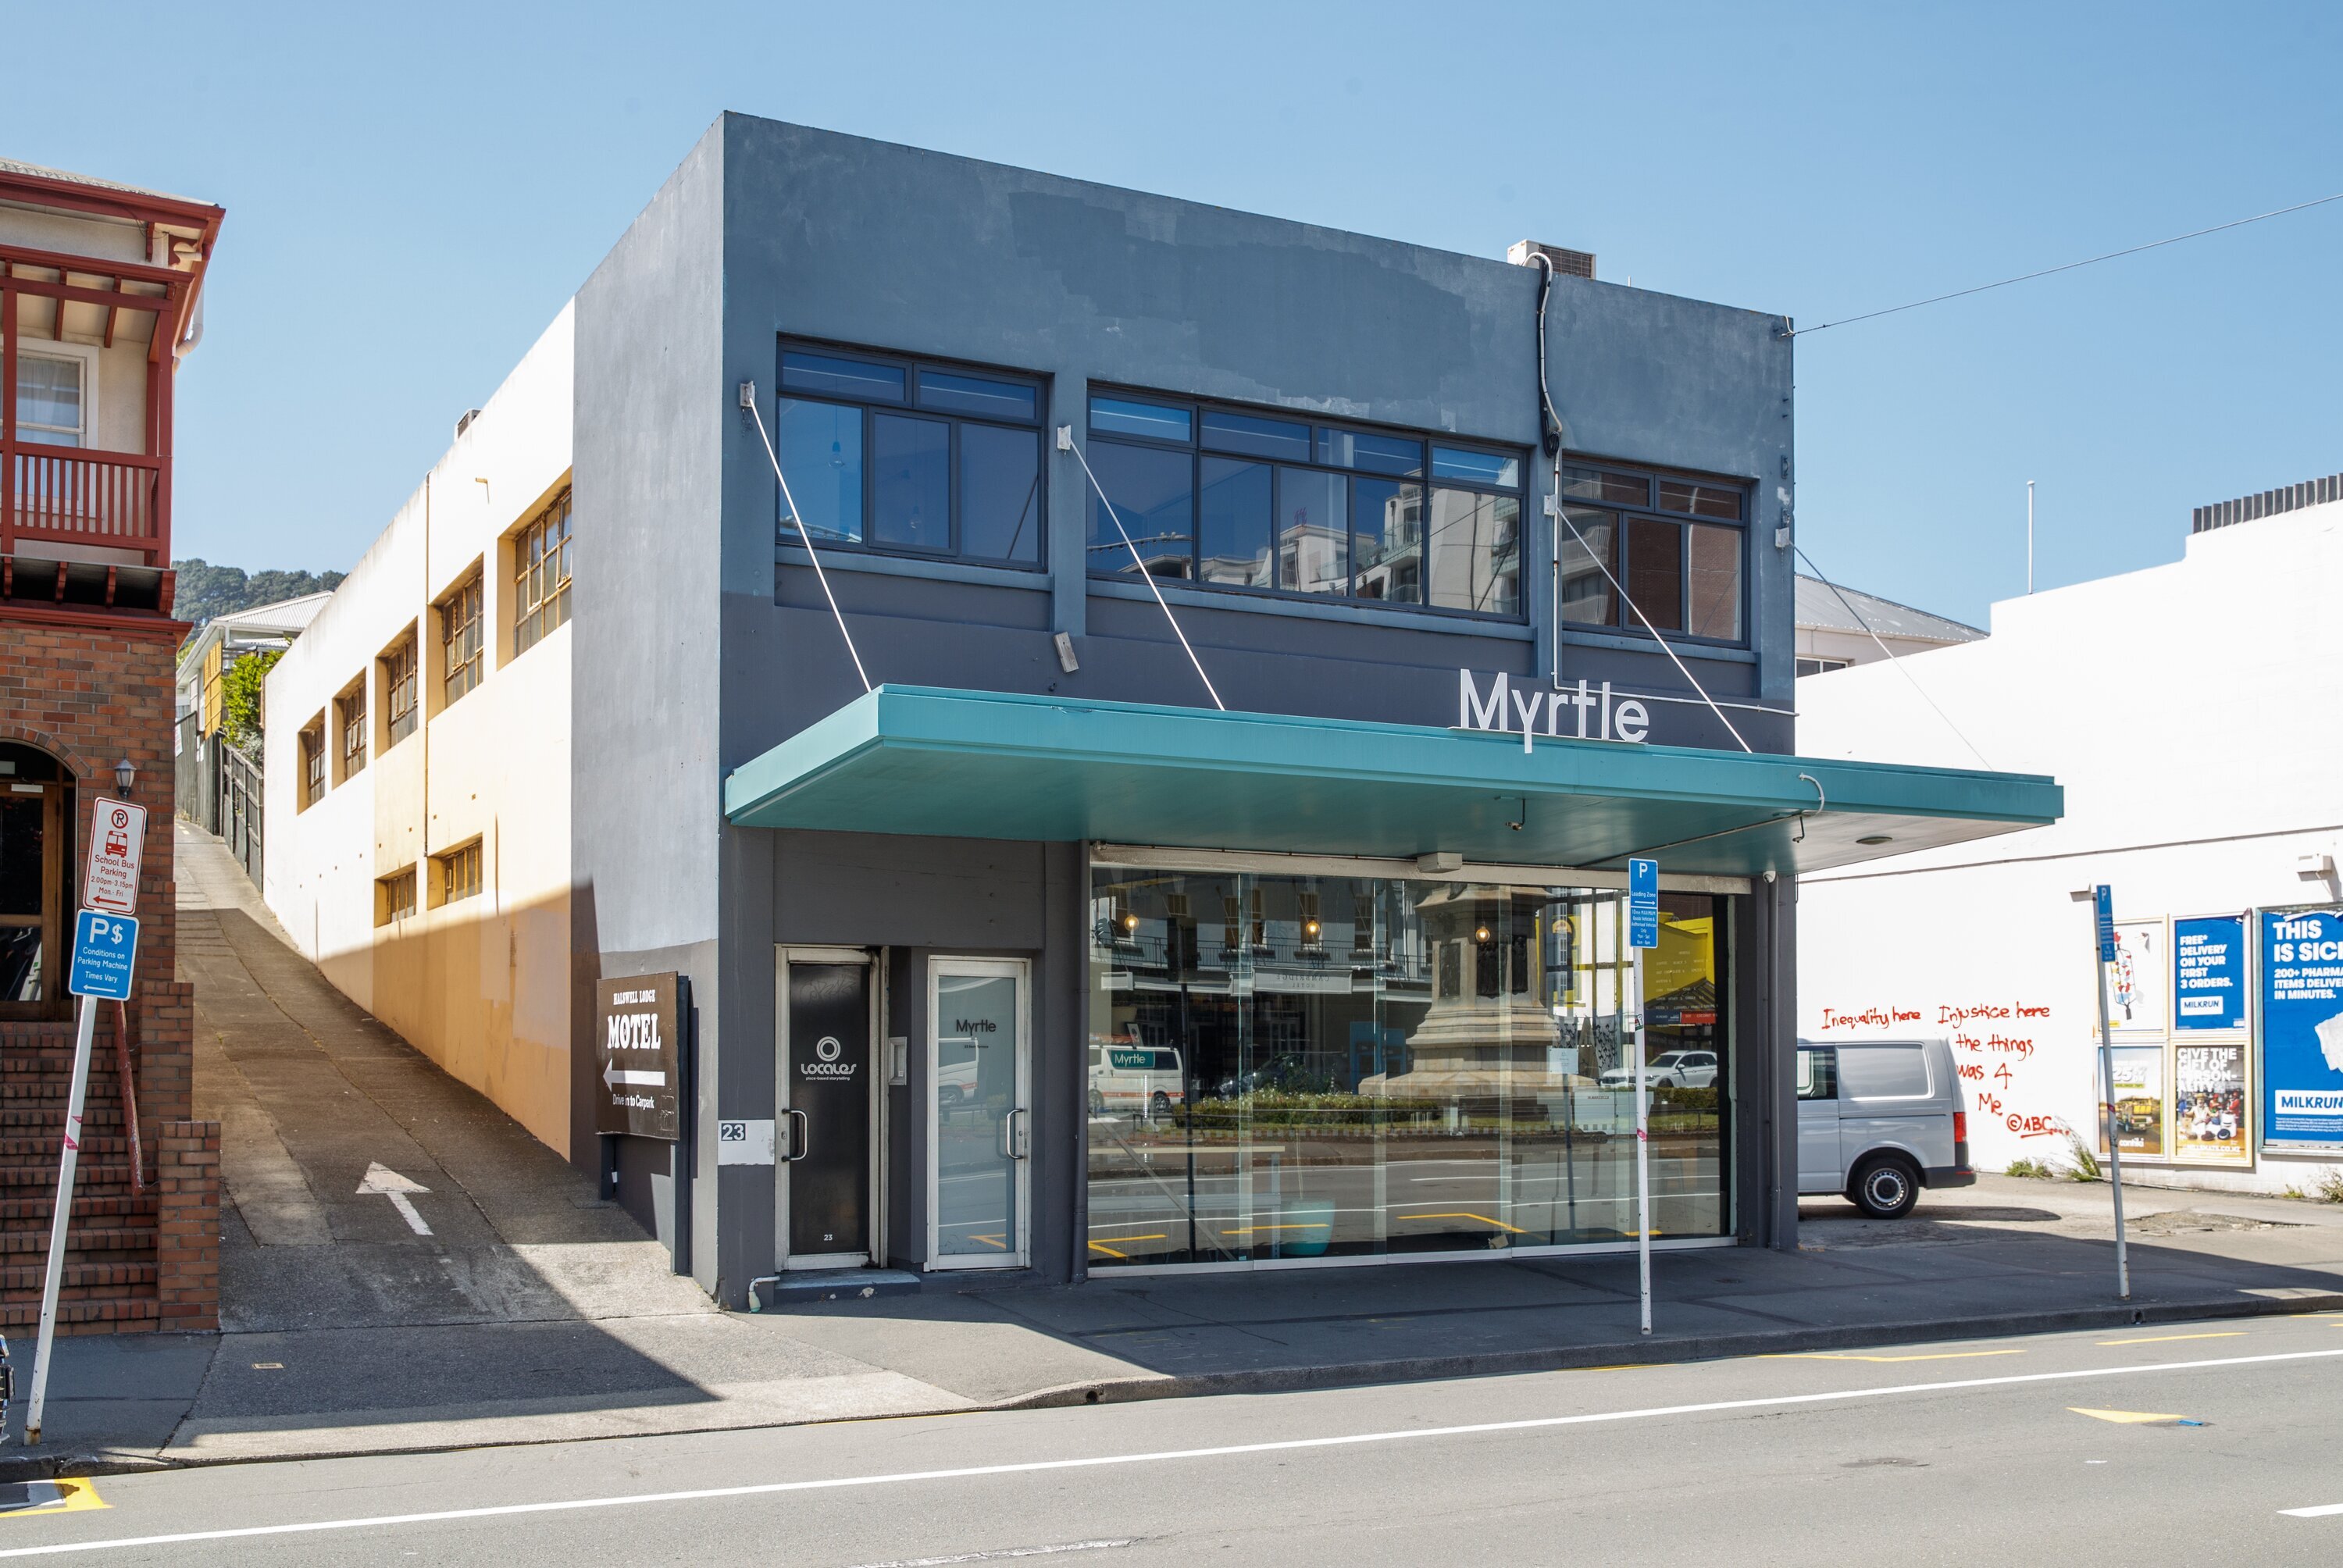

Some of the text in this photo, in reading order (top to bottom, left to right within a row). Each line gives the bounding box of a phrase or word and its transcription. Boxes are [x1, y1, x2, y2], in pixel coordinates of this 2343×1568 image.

[1460, 668, 1649, 754] Myrtle
[95, 854, 135, 869] School Bus
[100, 866, 127, 879] Parking
[1639, 862, 1648, 878] P
[2101, 887, 2107, 902] P
[2273, 920, 2323, 940] THIS
[83, 946, 116, 958] Conditions
[2180, 944, 2227, 957] DELIVERY
[2273, 943, 2295, 962] IS
[77, 956, 128, 970] Parking Machine
[2180, 956, 2226, 967] ON YOUR
[85, 971, 118, 983] Times Vary
[2180, 968, 2208, 978] FIRST
[2274, 968, 2300, 978] 200+
[2180, 977, 2234, 989] 3 ORDERS.
[2274, 978, 2306, 989] ITEMS
[613, 989, 656, 1005] HALSWELL LODGE
[2274, 989, 2337, 1000] IN MINUTES.
[1821, 1006, 1921, 1029] Inequality here
[1938, 1001, 2050, 1028] Injustice here
[607, 1013, 662, 1049] MOTEL
[956, 1019, 997, 1036] Myrtle
[1956, 1033, 2034, 1061] the things
[2177, 1047, 2238, 1060] GIVE THE
[1114, 1053, 1146, 1067] Myrtle
[2209, 1059, 2227, 1071] OF
[1956, 1063, 2013, 1089] was 4
[612, 1093, 654, 1110] Drive in to Carpark
[1978, 1092, 2002, 1116] Me
[722, 1124, 744, 1140] 23
